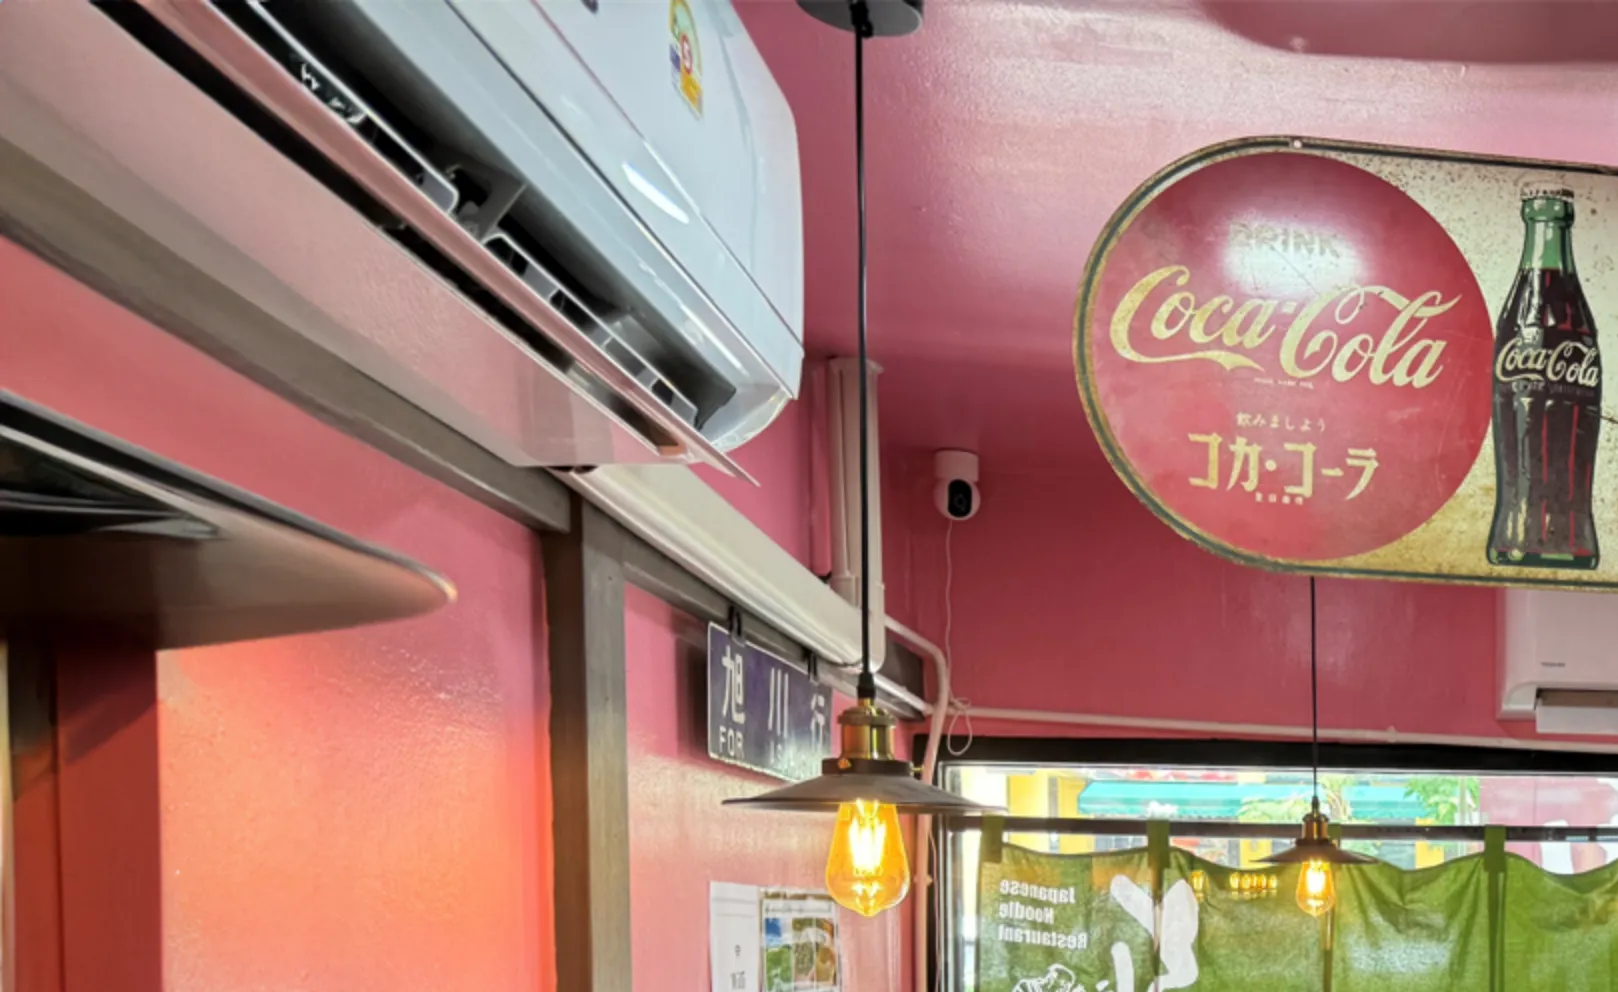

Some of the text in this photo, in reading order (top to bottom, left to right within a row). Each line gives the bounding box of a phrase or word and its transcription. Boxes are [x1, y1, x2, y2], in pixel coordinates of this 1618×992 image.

[1109, 264, 1463, 389] Coca-Cola
[1495, 337, 1600, 388] Coca-Cola
[1187, 431, 1380, 501] コカ・コーラ
[719, 725, 745, 759] FOR
